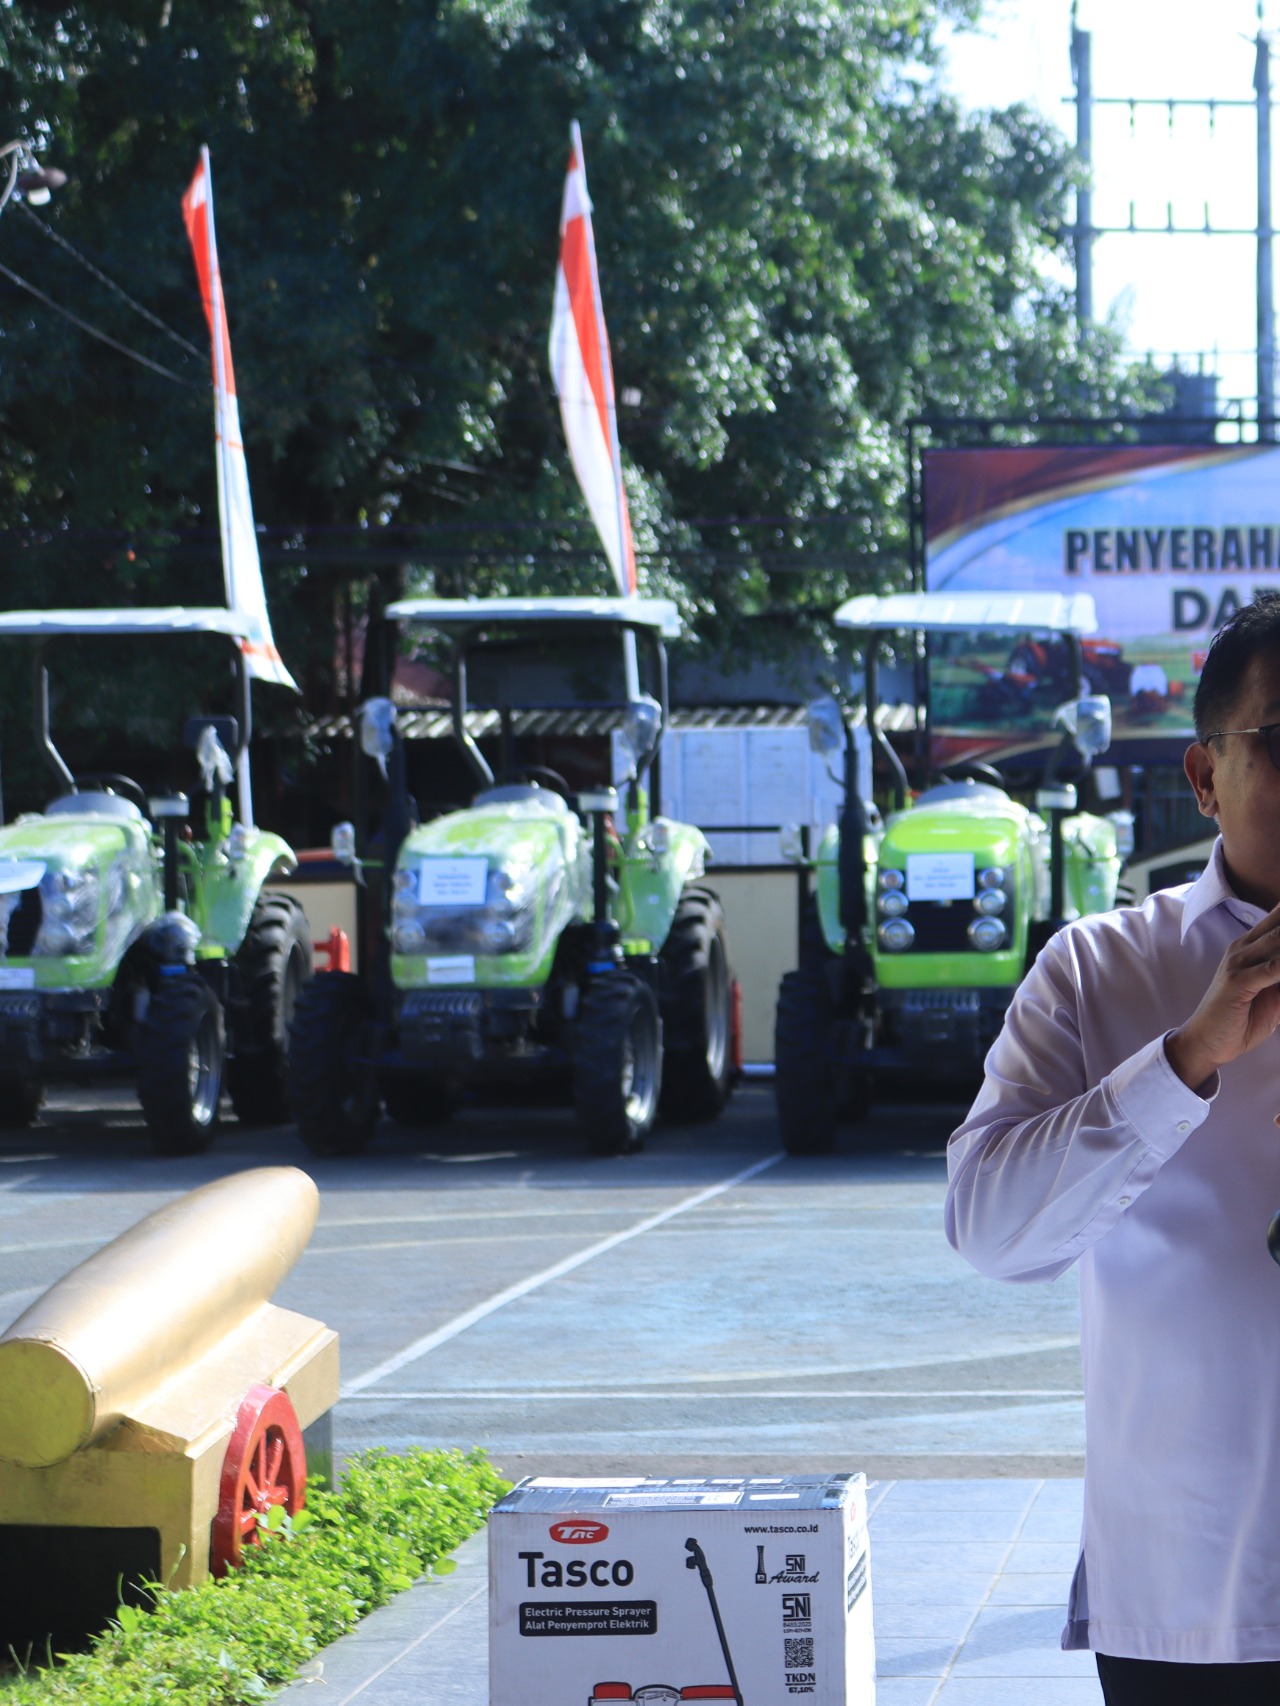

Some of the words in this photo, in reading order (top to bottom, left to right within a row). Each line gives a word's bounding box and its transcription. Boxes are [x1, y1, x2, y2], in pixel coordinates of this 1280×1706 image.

[744, 1524, 819, 1534] www.tasco.co.id
[518, 1552, 634, 1587] Tasco
[768, 1570, 820, 1584] Award
[525, 1607, 563, 1617] Electric
[565, 1607, 610, 1616] Pressure
[612, 1606, 652, 1618] Sprayer
[782, 1596, 811, 1618] SNI
[525, 1620, 546, 1630] Alat
[548, 1620, 607, 1632] Penyemprot
[610, 1619, 649, 1629] Elektrik
[785, 1673, 816, 1682] TKDN
